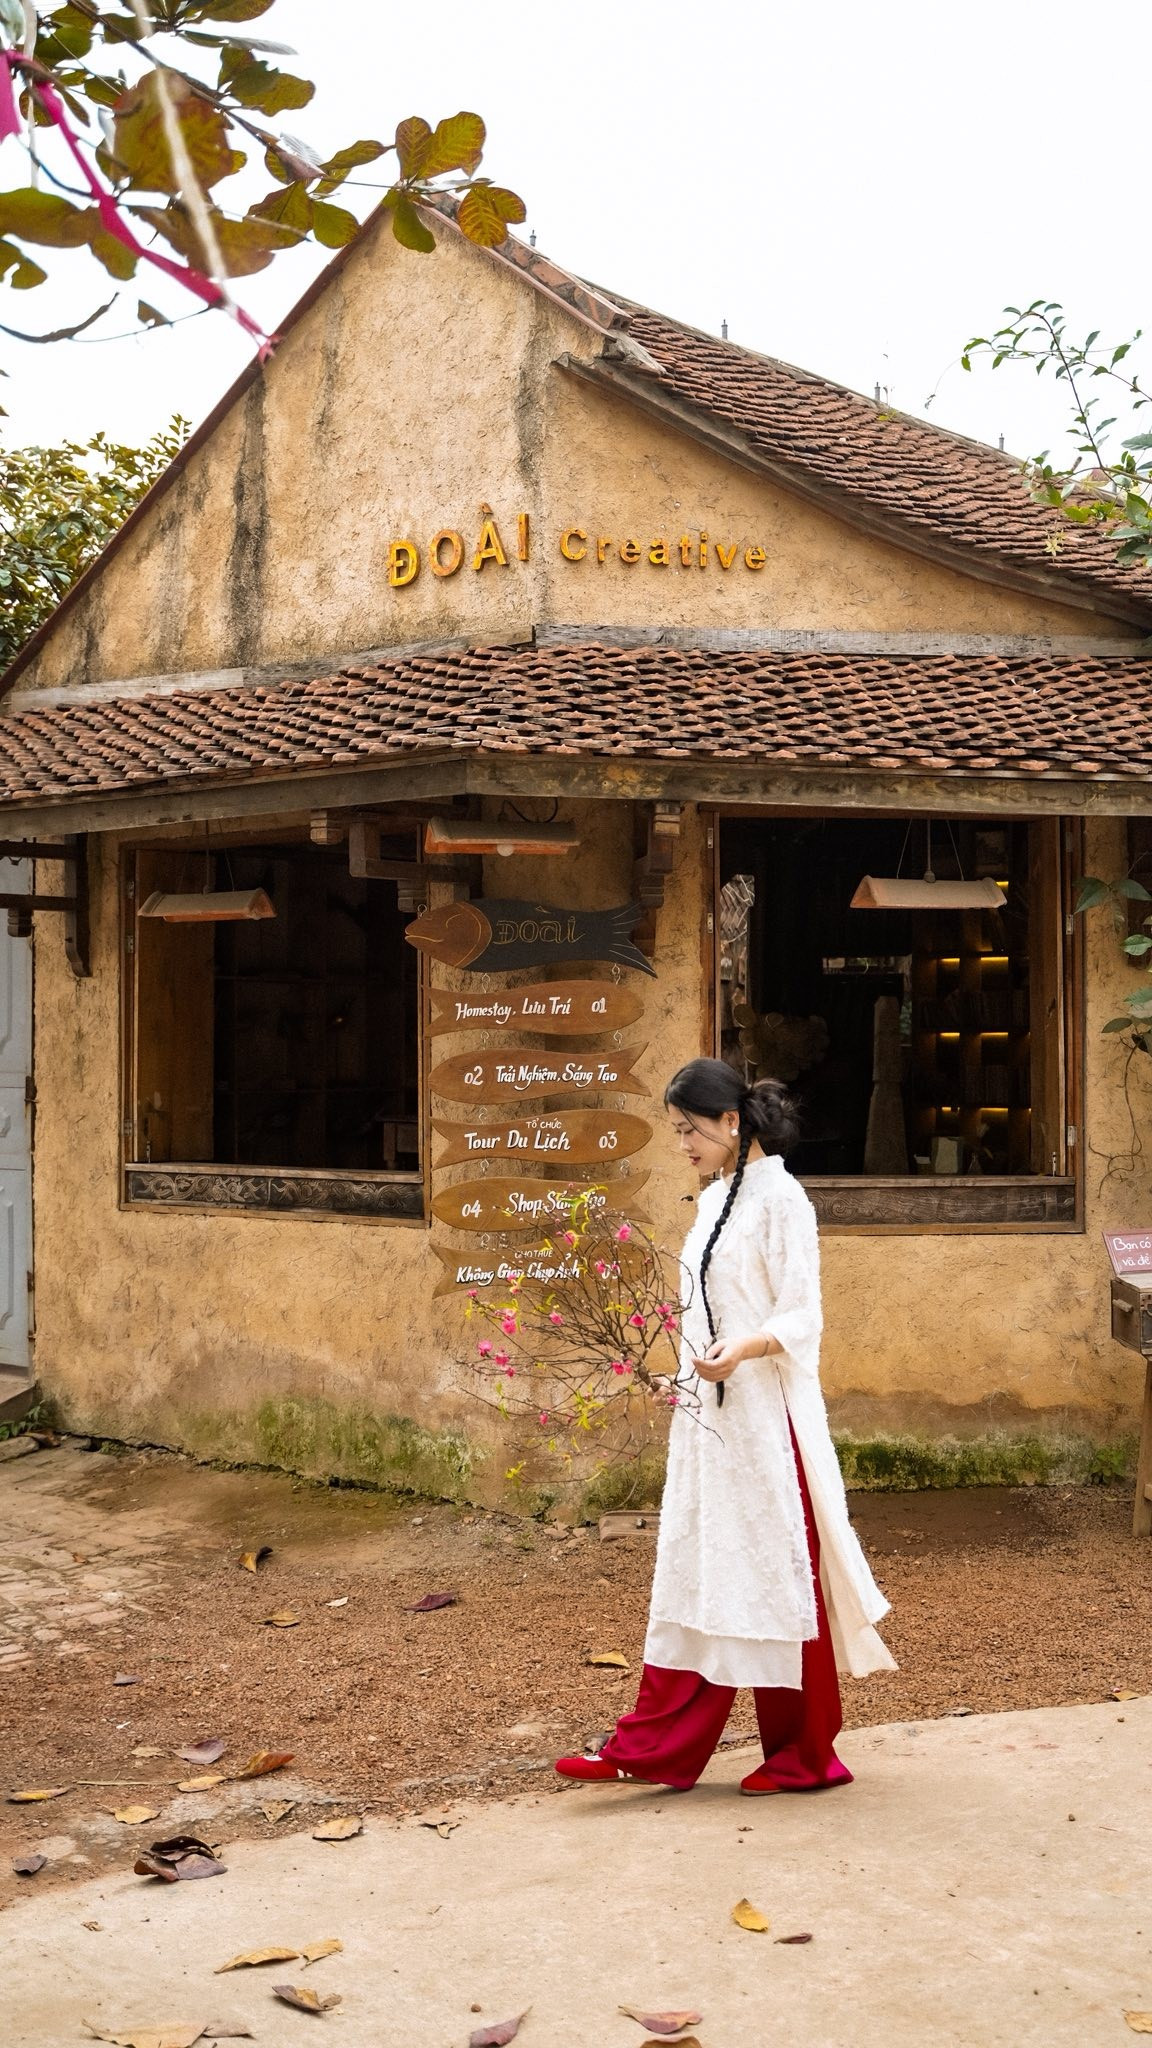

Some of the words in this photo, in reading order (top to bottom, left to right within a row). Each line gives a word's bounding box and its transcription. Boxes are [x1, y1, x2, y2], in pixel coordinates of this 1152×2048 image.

[386, 502, 530, 588] ĐOÀI
[561, 528, 767, 570] Creative
[522, 998, 546, 1015] Lưu
[549, 997, 572, 1015] Trú
[496, 1065, 516, 1083] Trải
[562, 1063, 593, 1088] Sáng
[597, 1064, 618, 1084] Tạo
[464, 1132, 501, 1150] Tour
[507, 1130, 528, 1149] Du
[534, 1130, 571, 1152] Lịch
[506, 1192, 543, 1219] Shop
[1113, 1237, 1138, 1252] Bạn
[1139, 1237, 1151, 1249] có
[456, 1264, 495, 1286] Không
